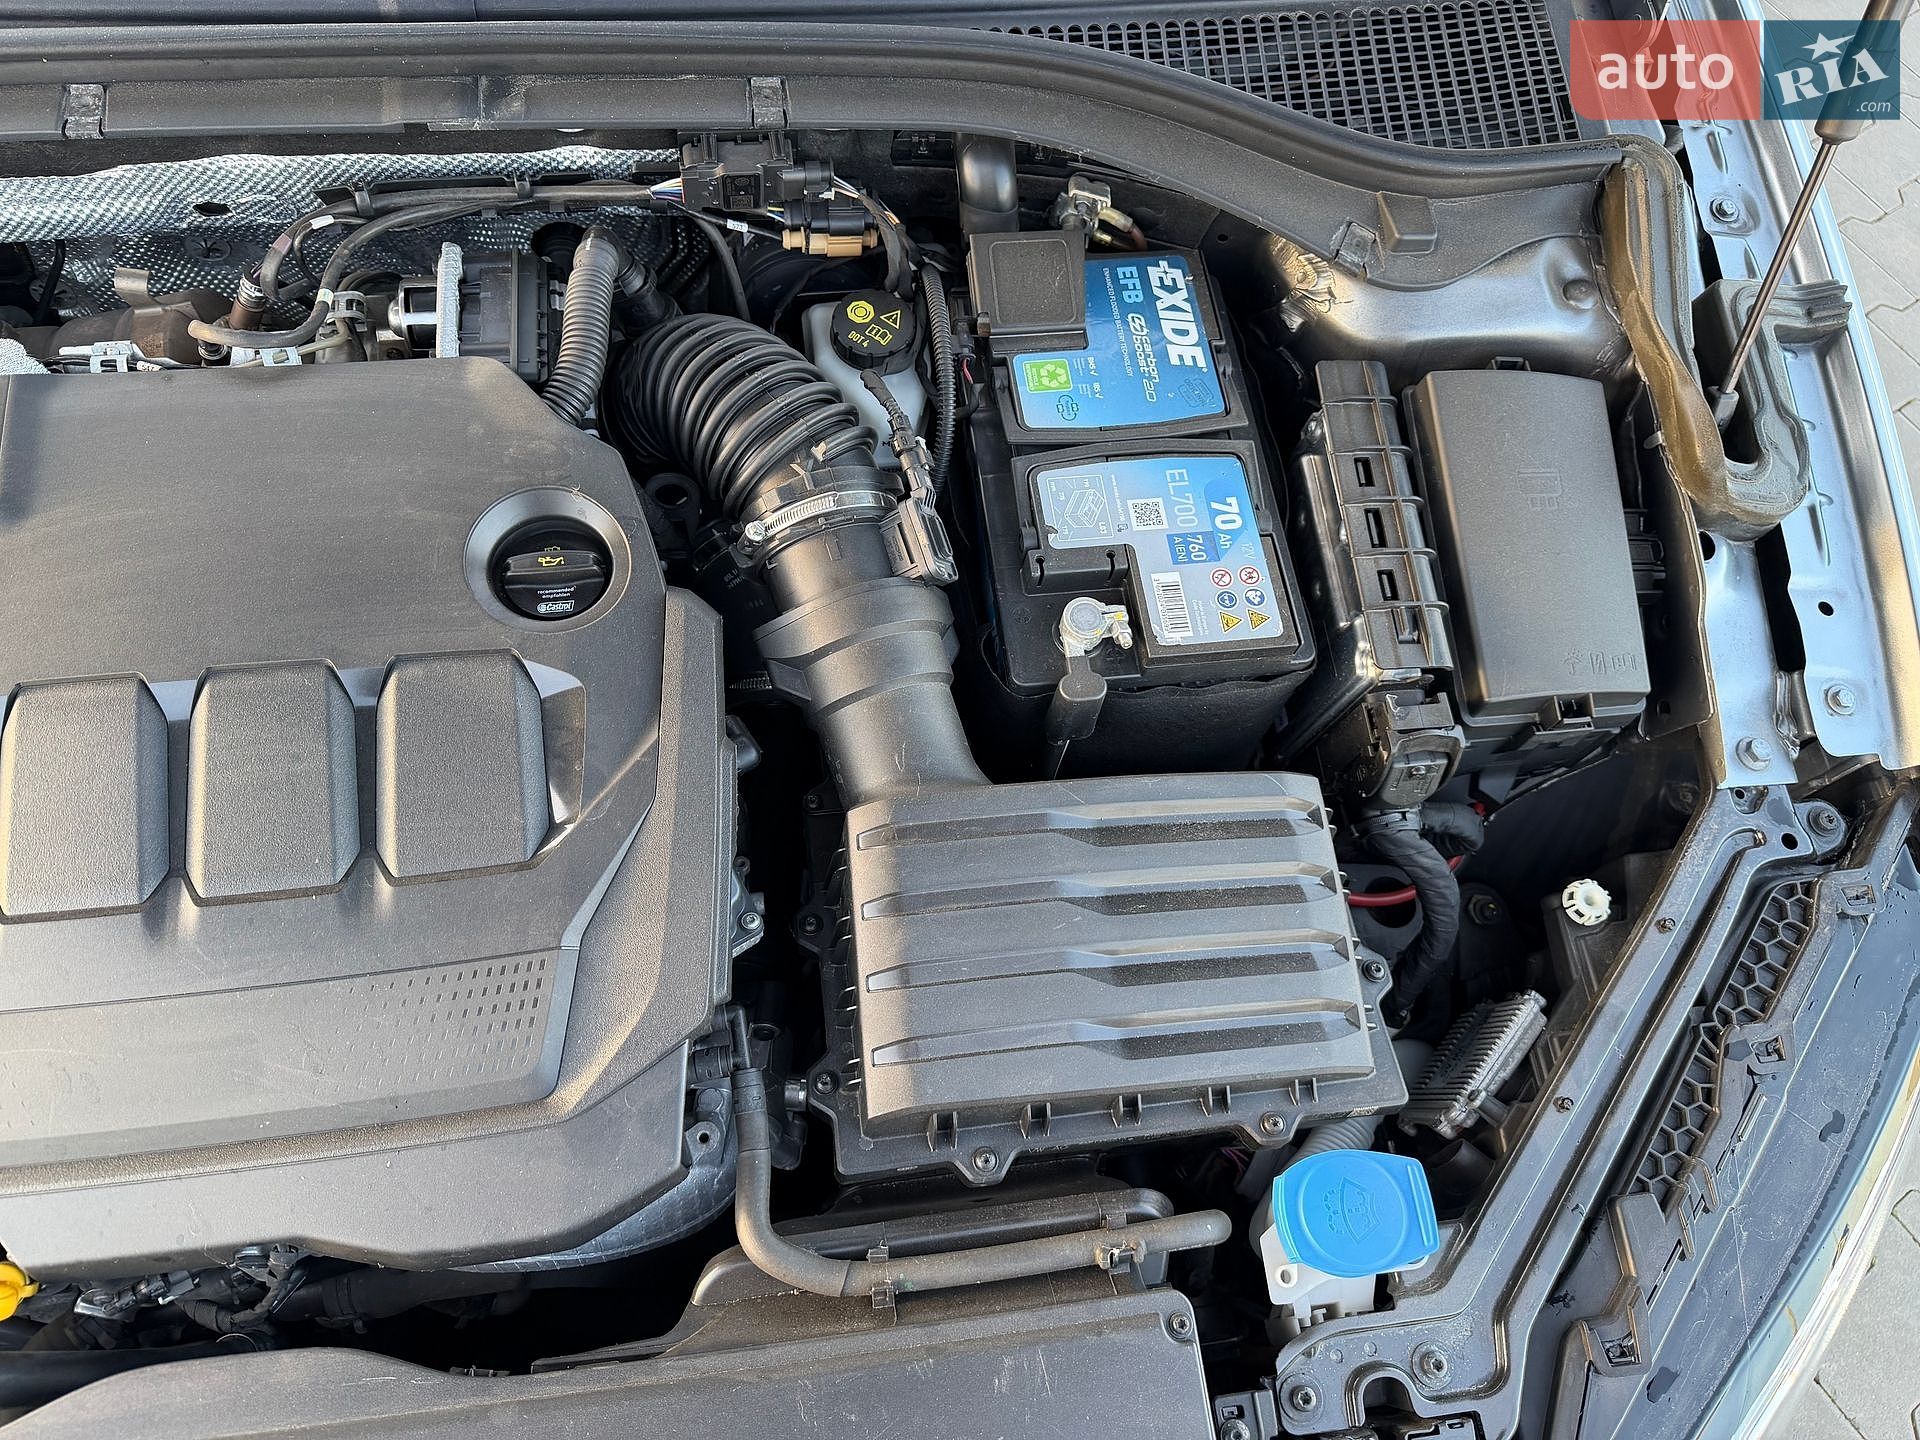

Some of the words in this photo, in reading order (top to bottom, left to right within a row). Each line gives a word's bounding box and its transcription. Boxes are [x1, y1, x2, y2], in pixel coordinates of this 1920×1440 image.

[1102, 267, 1115, 296] ENHANCED
[1117, 266, 1144, 304] EFB
[1107, 296, 1121, 320] FLOODED
[1147, 260, 1207, 368] EXIDE
[848, 330, 865, 344] DOT
[862, 339, 870, 347] 4
[1114, 320, 1127, 343] BATTERY
[1119, 343, 1134, 377] TECHNOLOGY
[1132, 335, 1150, 374] boost
[1143, 335, 1160, 383] carbon
[1165, 468, 1198, 527] EL700
[1210, 495, 1243, 530] 70
[1186, 534, 1208, 561] 760
[1218, 533, 1233, 549] Ah
[537, 585, 576, 594] recommended
[546, 602, 571, 611] Castrol
